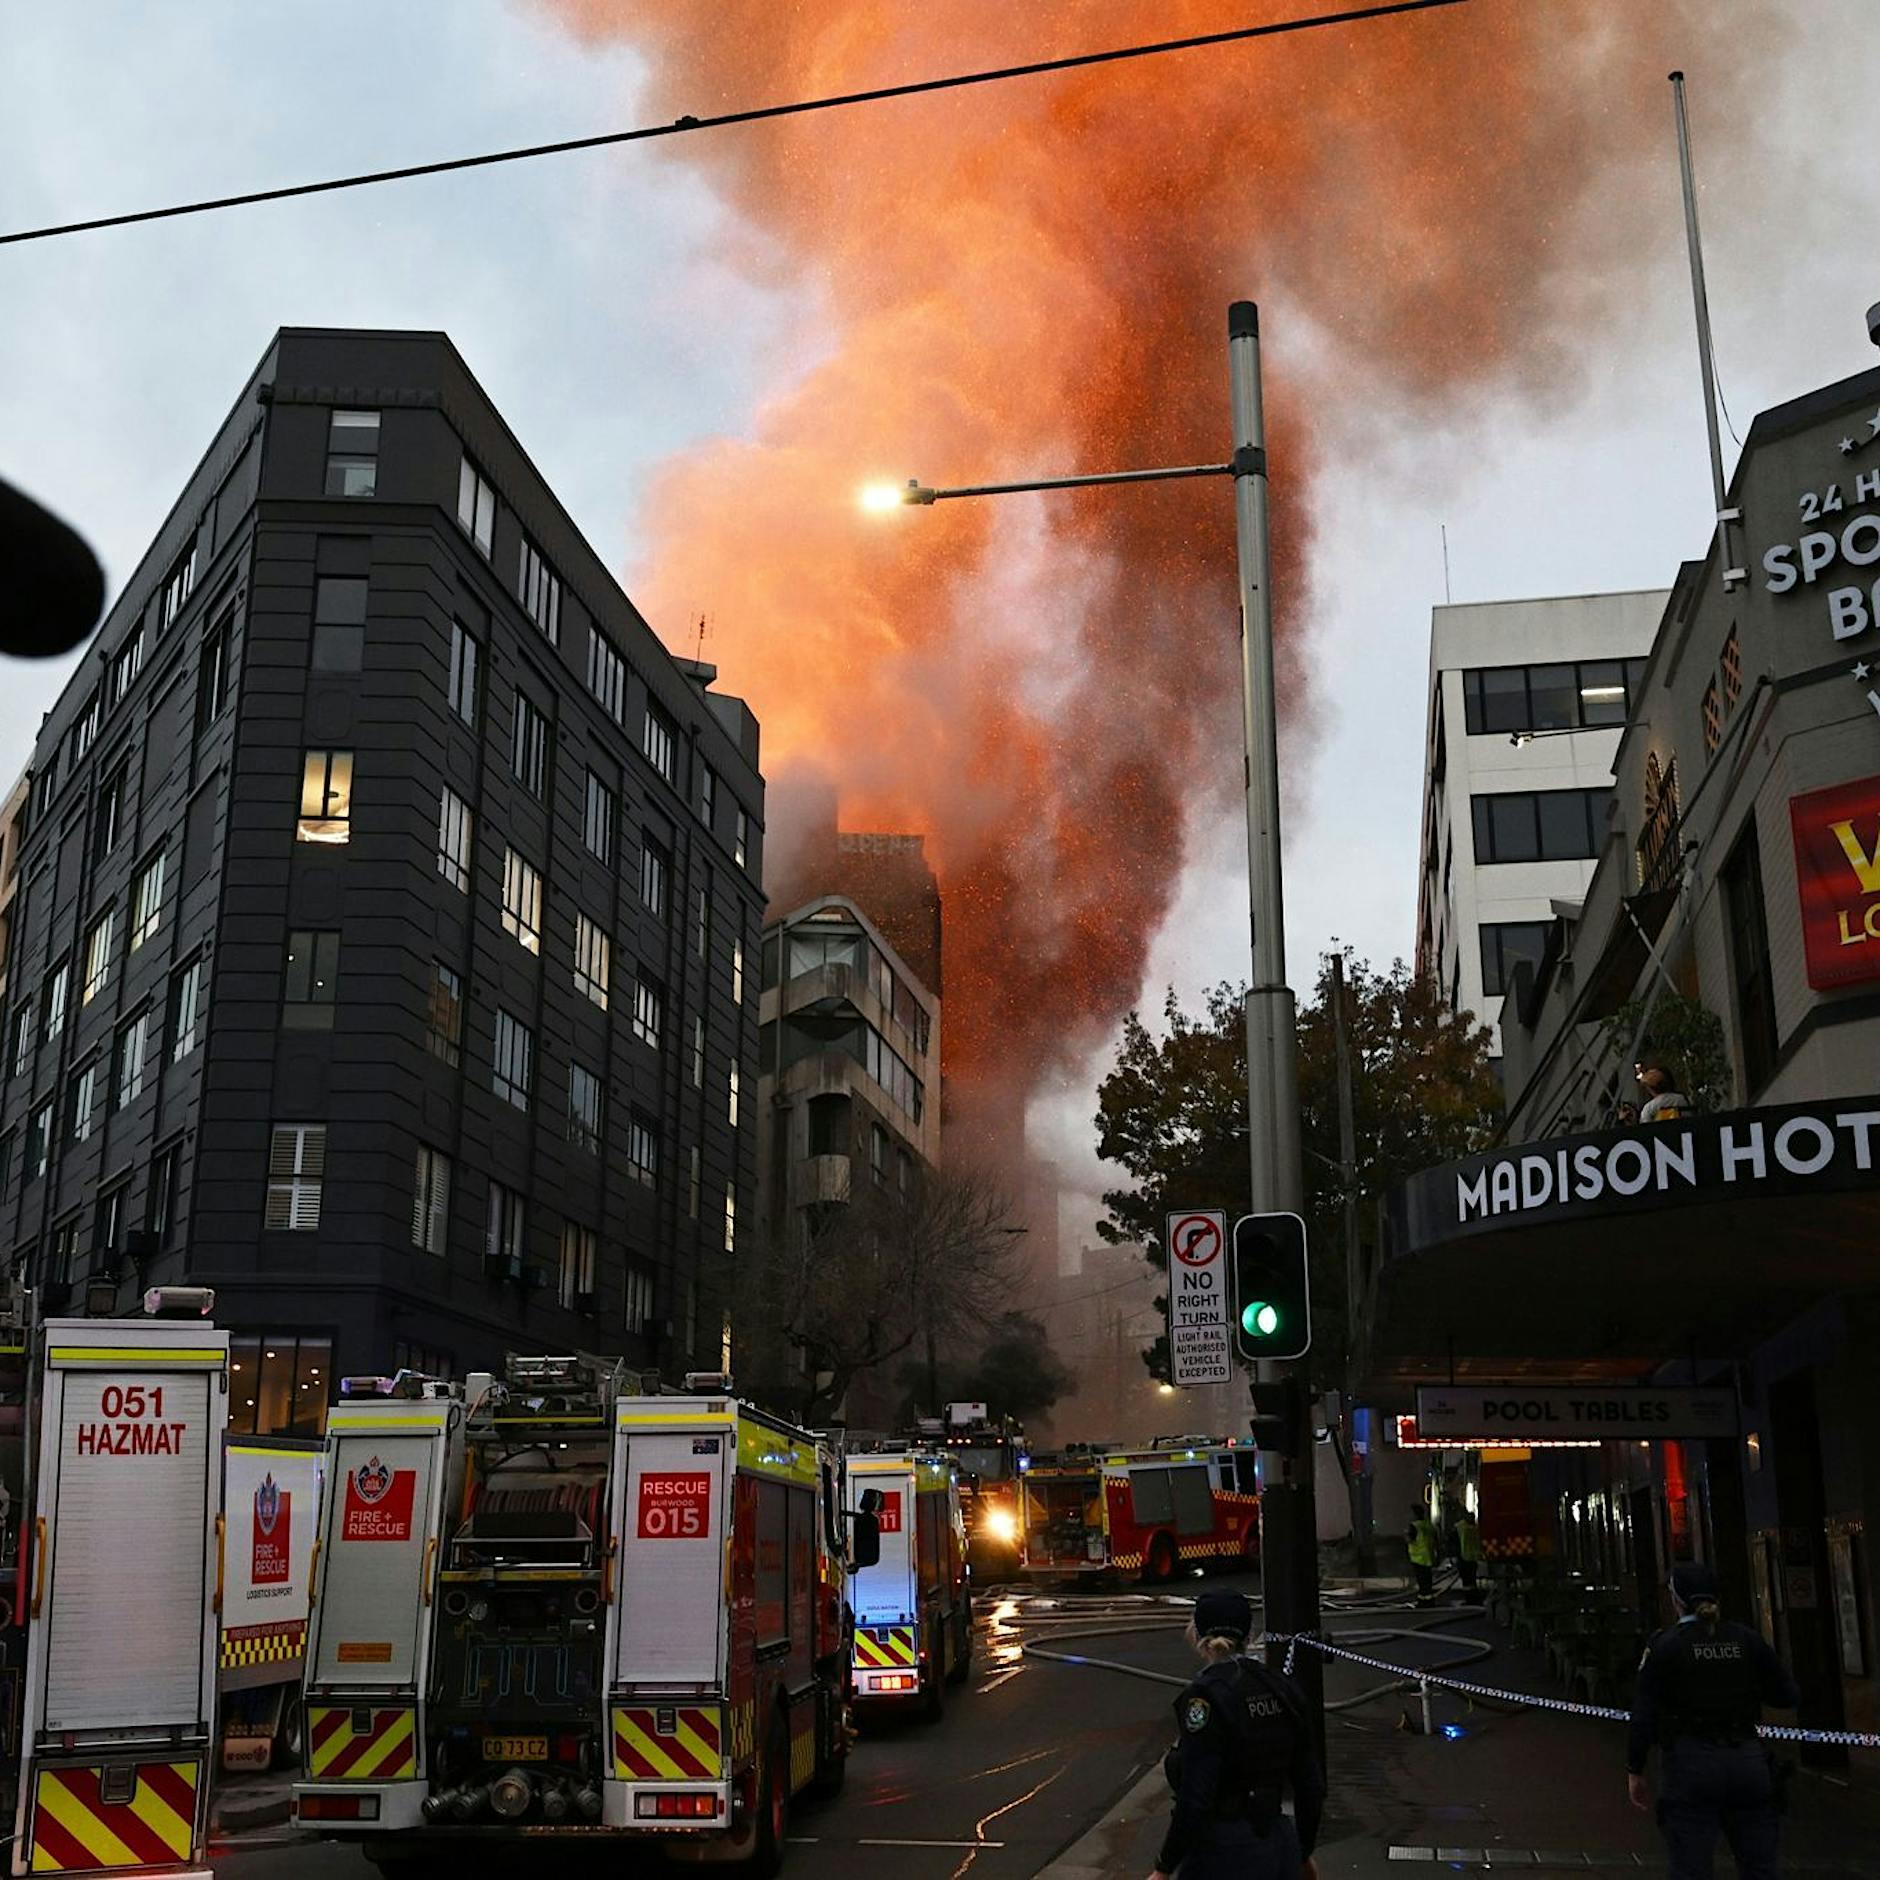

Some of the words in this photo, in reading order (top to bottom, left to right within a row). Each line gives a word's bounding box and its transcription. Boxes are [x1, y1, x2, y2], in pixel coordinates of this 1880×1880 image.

[1799, 484, 1842, 523] 24
[1827, 577, 1880, 641] B
[1456, 1132, 1697, 1223] MADISON
[1183, 1272, 1213, 1290] NO
[1178, 1294, 1219, 1308] RIGHT
[1180, 1312, 1219, 1324] TURN
[1177, 1332, 1200, 1342] LIGHT
[1203, 1331, 1223, 1340] RAIL
[1176, 1342, 1226, 1354] AUTHORISED
[1182, 1354, 1221, 1366] VEHICLE
[1179, 1366, 1226, 1378] EXCEPTED
[101, 1386, 163, 1418] 051
[1483, 1401, 1558, 1421] POOL
[1568, 1400, 1671, 1422] TABLES
[77, 1423, 186, 1455] HAZMAT
[643, 1480, 708, 1496] RESCUE
[650, 1499, 695, 1507] BURWOOD
[349, 1510, 382, 1524] FIRE
[645, 1507, 700, 1535] 015
[348, 1522, 406, 1536] RESCUE
[255, 1544, 274, 1559] FIRE
[255, 1559, 287, 1576] RESCUE
[246, 1589, 271, 1600] LOGISTICS
[271, 1586, 293, 1598] SUPPORT
[1693, 1646, 1741, 1660] POLICE
[507, 1740, 524, 1755] 73
[528, 1740, 546, 1755] CZ
